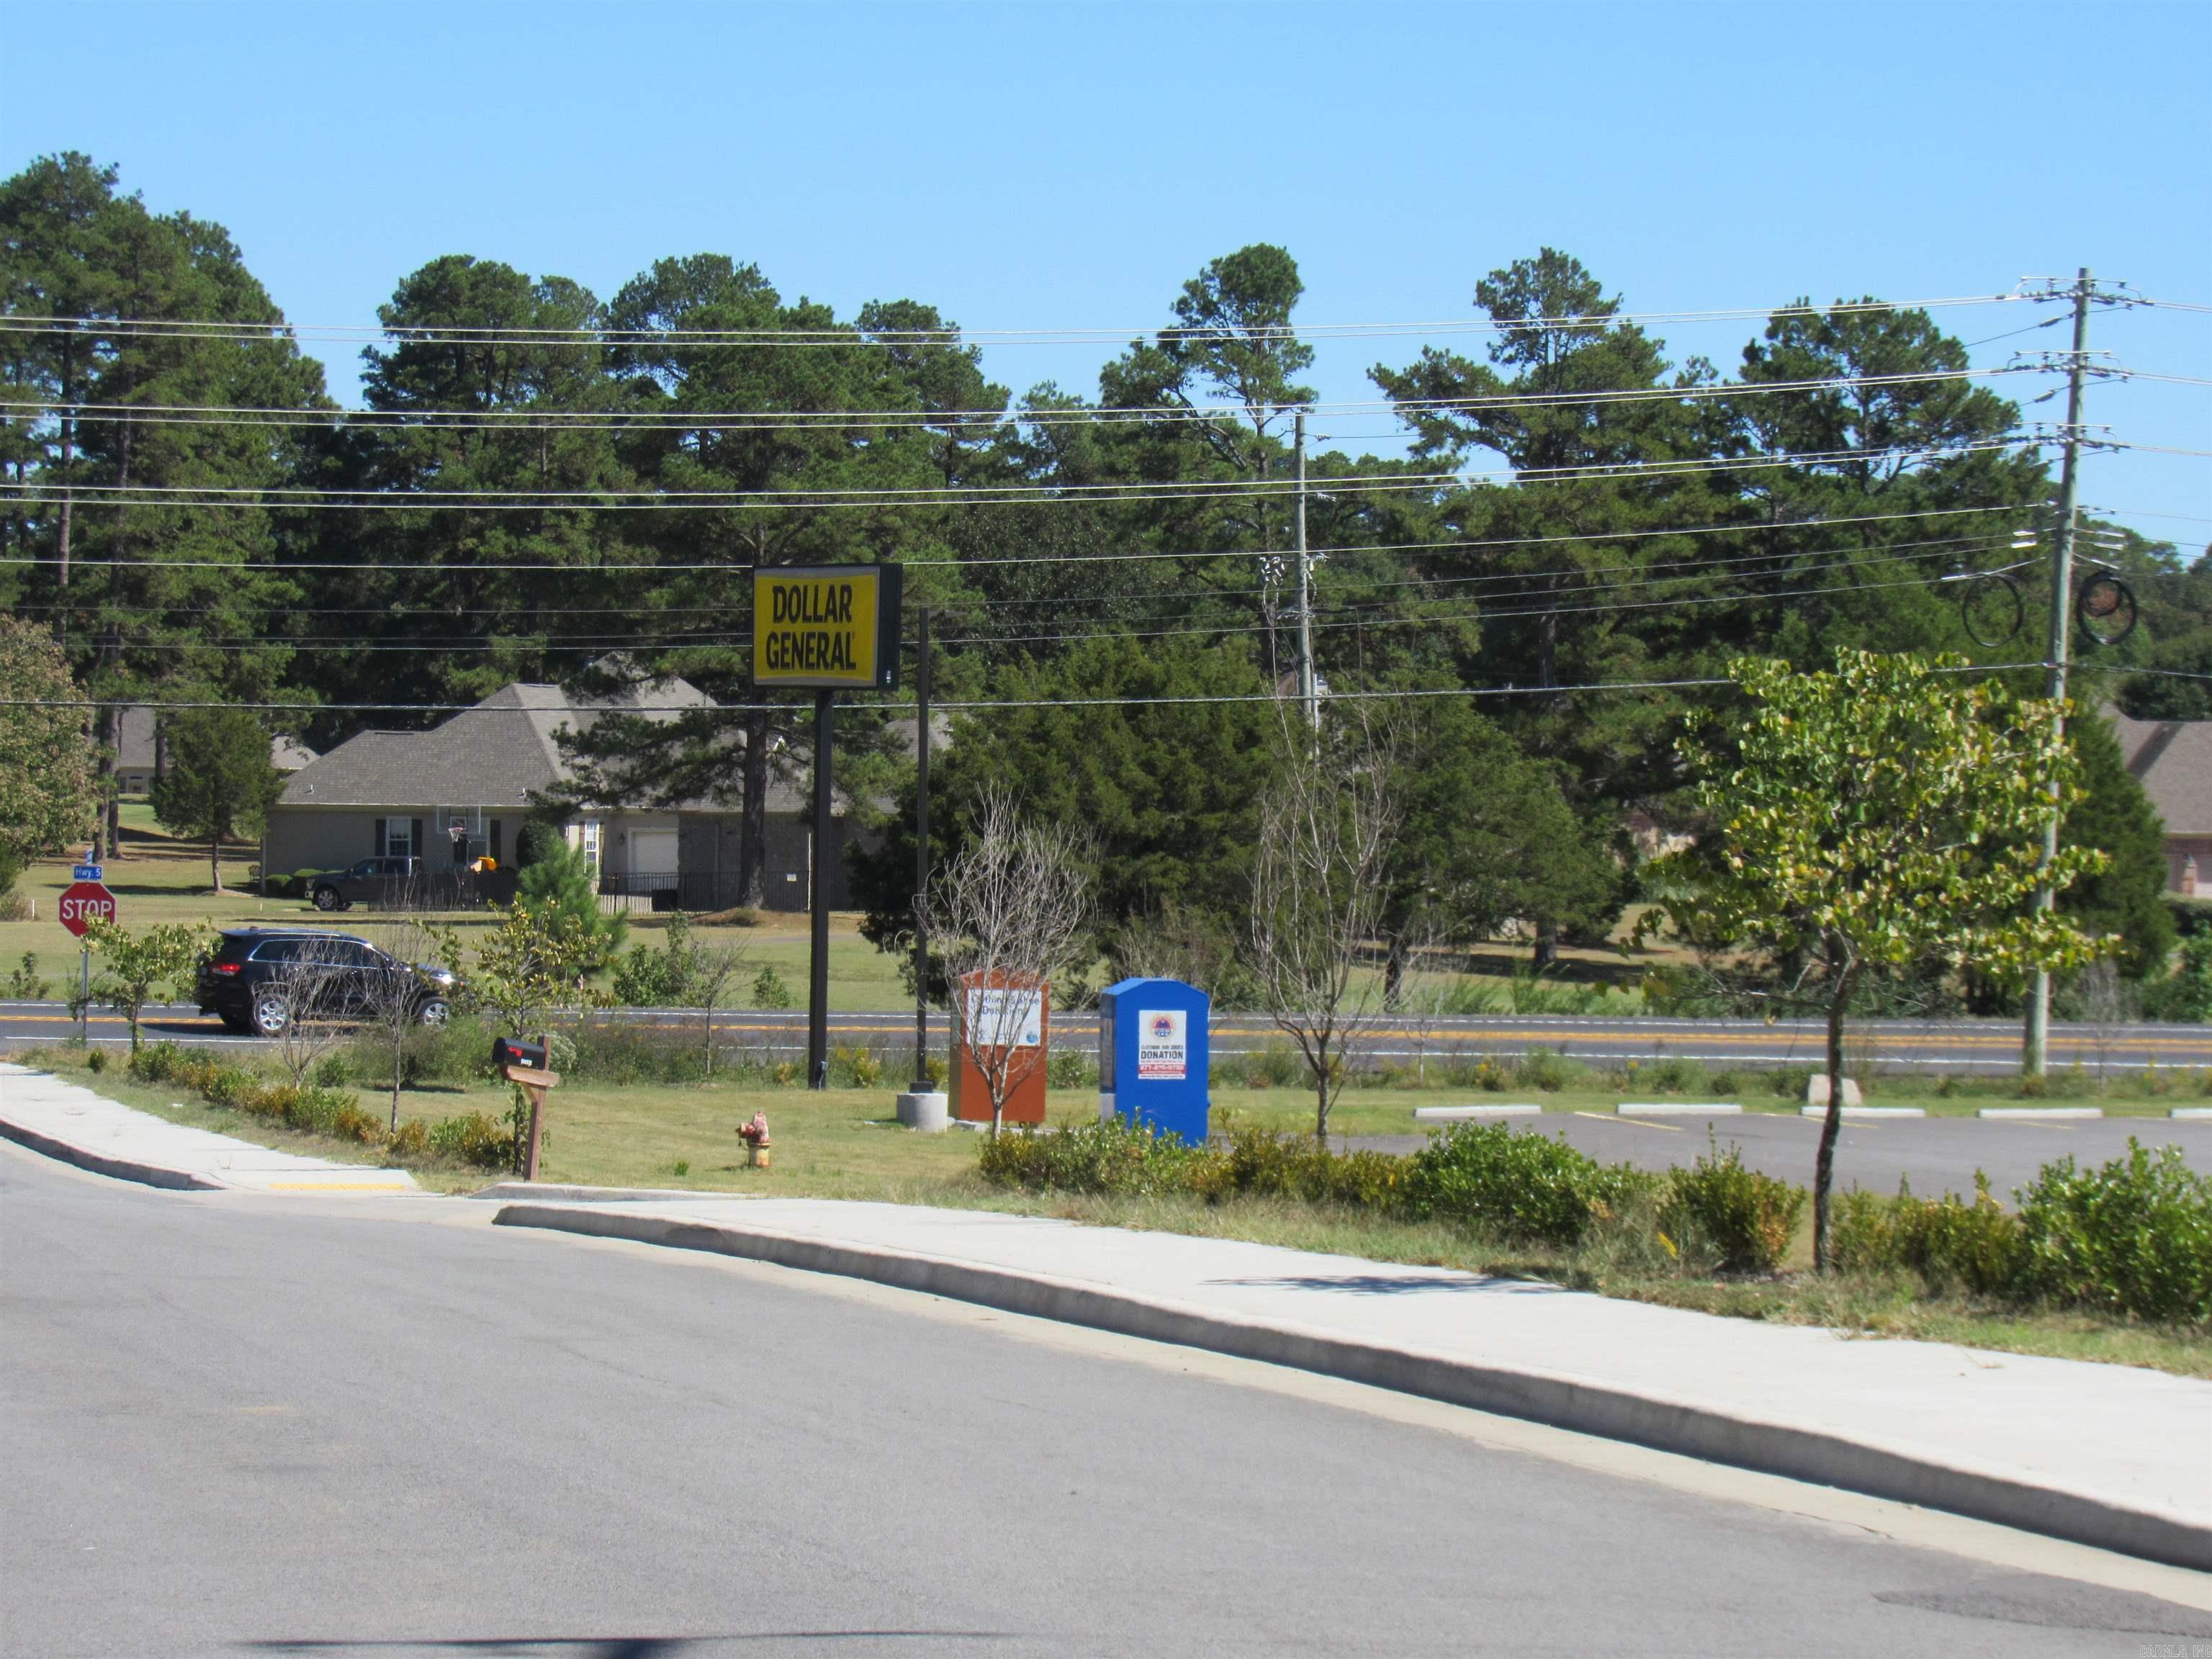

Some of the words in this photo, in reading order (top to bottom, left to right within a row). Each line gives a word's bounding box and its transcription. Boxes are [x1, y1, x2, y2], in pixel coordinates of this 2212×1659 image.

[773, 584, 853, 624] DOLLAR
[765, 631, 857, 671] GENERAL
[75, 868, 94, 878] Hwy.
[96, 868, 101, 876] 5
[63, 899, 112, 920] STOP
[1141, 1051, 1184, 1059] DONATION
